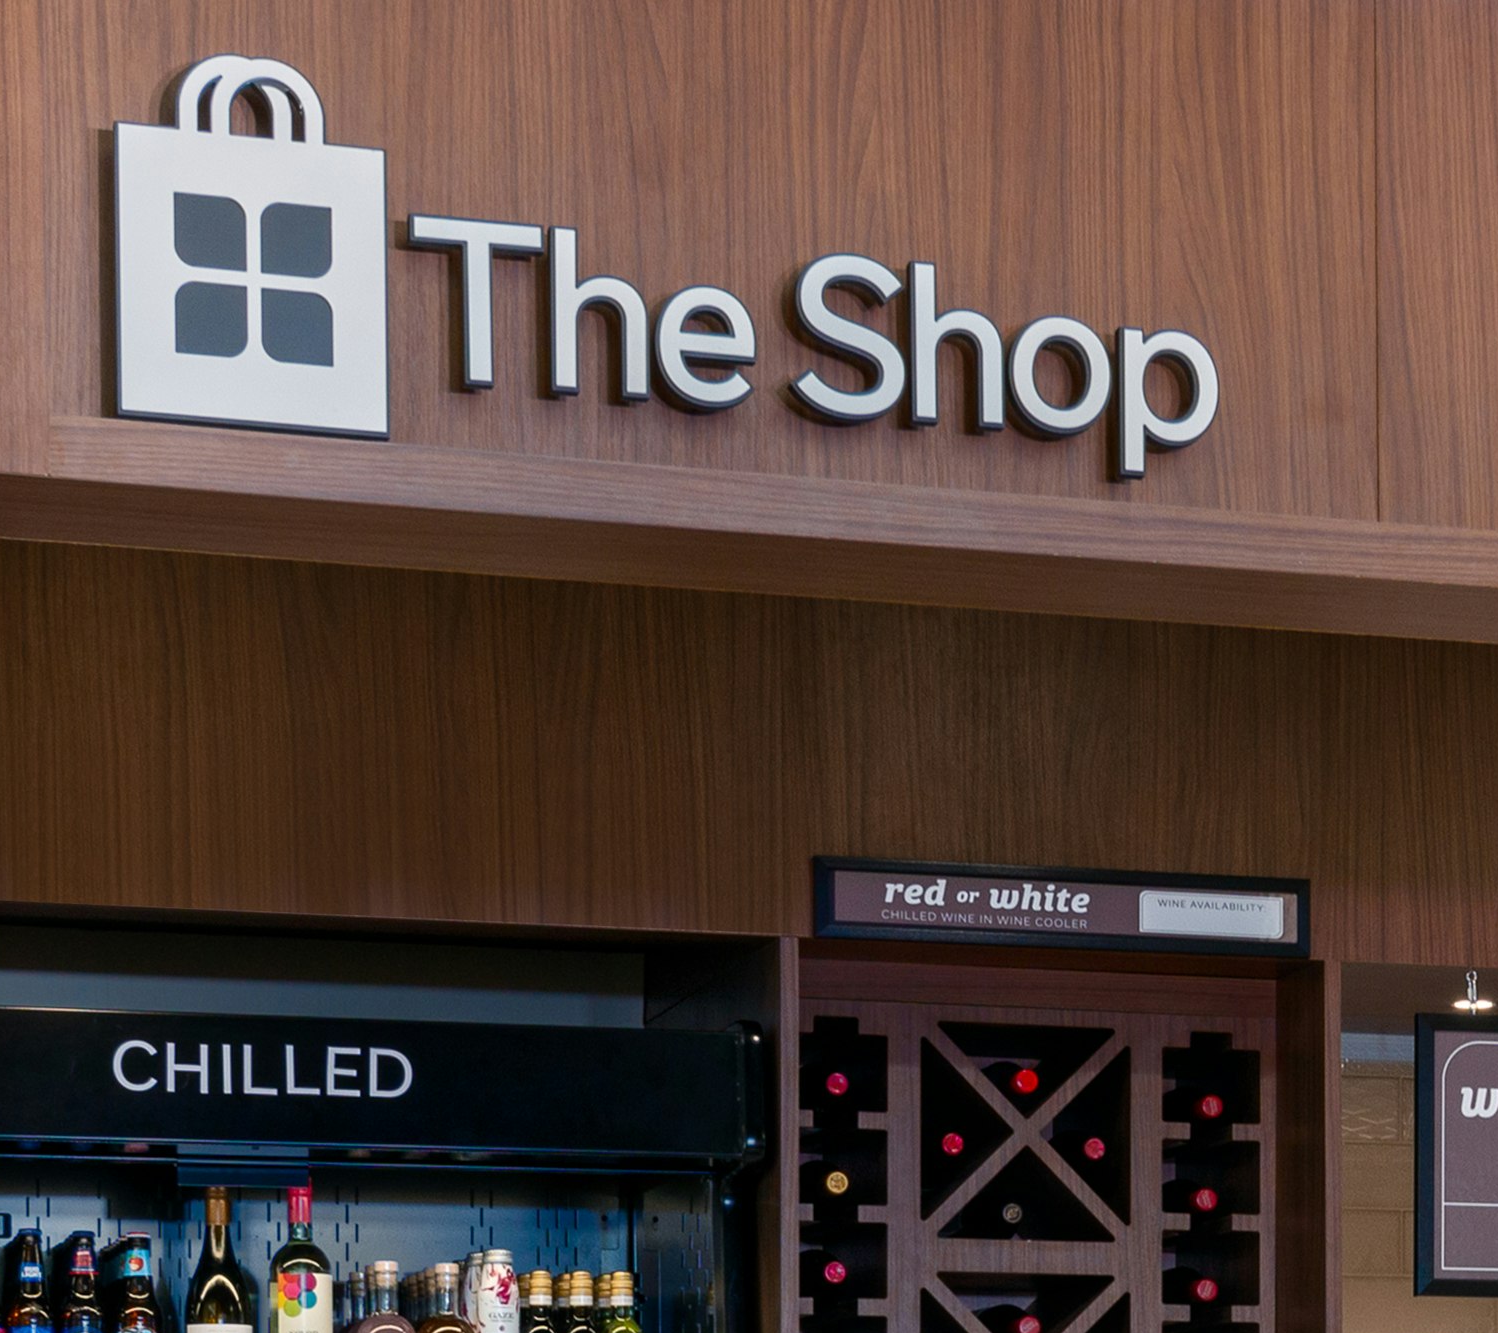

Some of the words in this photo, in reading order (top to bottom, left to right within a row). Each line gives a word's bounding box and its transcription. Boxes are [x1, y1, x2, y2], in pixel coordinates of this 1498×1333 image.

[406, 213, 758, 413] The
[788, 252, 1220, 480] Shop
[884, 879, 947, 906] red
[957, 888, 979, 904] or
[989, 882, 1091, 913] white
[1157, 899, 1186, 909] WINE
[1190, 900, 1265, 912] AVAILABILITY
[881, 909, 936, 922] CHILLED
[942, 912, 975, 924] WINE
[980, 914, 992, 925] IN
[997, 915, 1030, 927] WINE
[1035, 916, 1087, 929] COOLER
[112, 1040, 413, 1098] CHILLED
